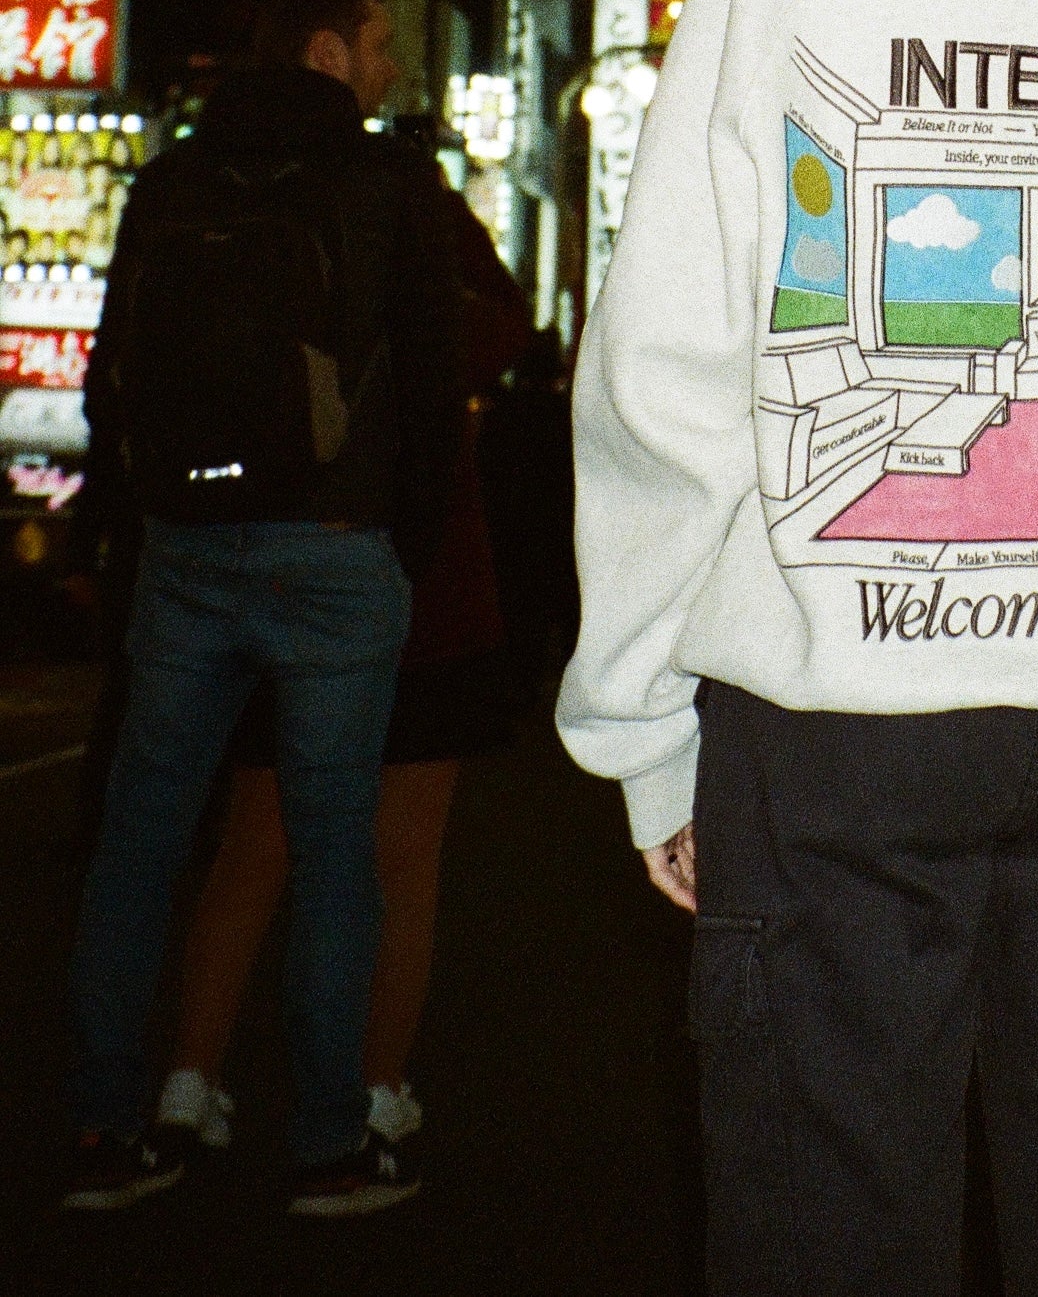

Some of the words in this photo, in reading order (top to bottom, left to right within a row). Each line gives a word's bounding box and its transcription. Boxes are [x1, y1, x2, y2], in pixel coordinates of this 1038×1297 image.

[902, 117, 946, 132] Believe
[946, 118, 956, 133] It
[958, 122, 970, 134] or
[972, 120, 993, 135] Not
[944, 149, 983, 166] Inside,
[984, 153, 1008, 168] your
[812, 443, 831, 460] Get
[830, 413, 887, 451] comfortable
[900, 452, 919, 464] Kick
[920, 453, 945, 466] back
[892, 550, 930, 569] Please,
[957, 552, 989, 566] Make
[992, 549, 1038, 563] Yourself
